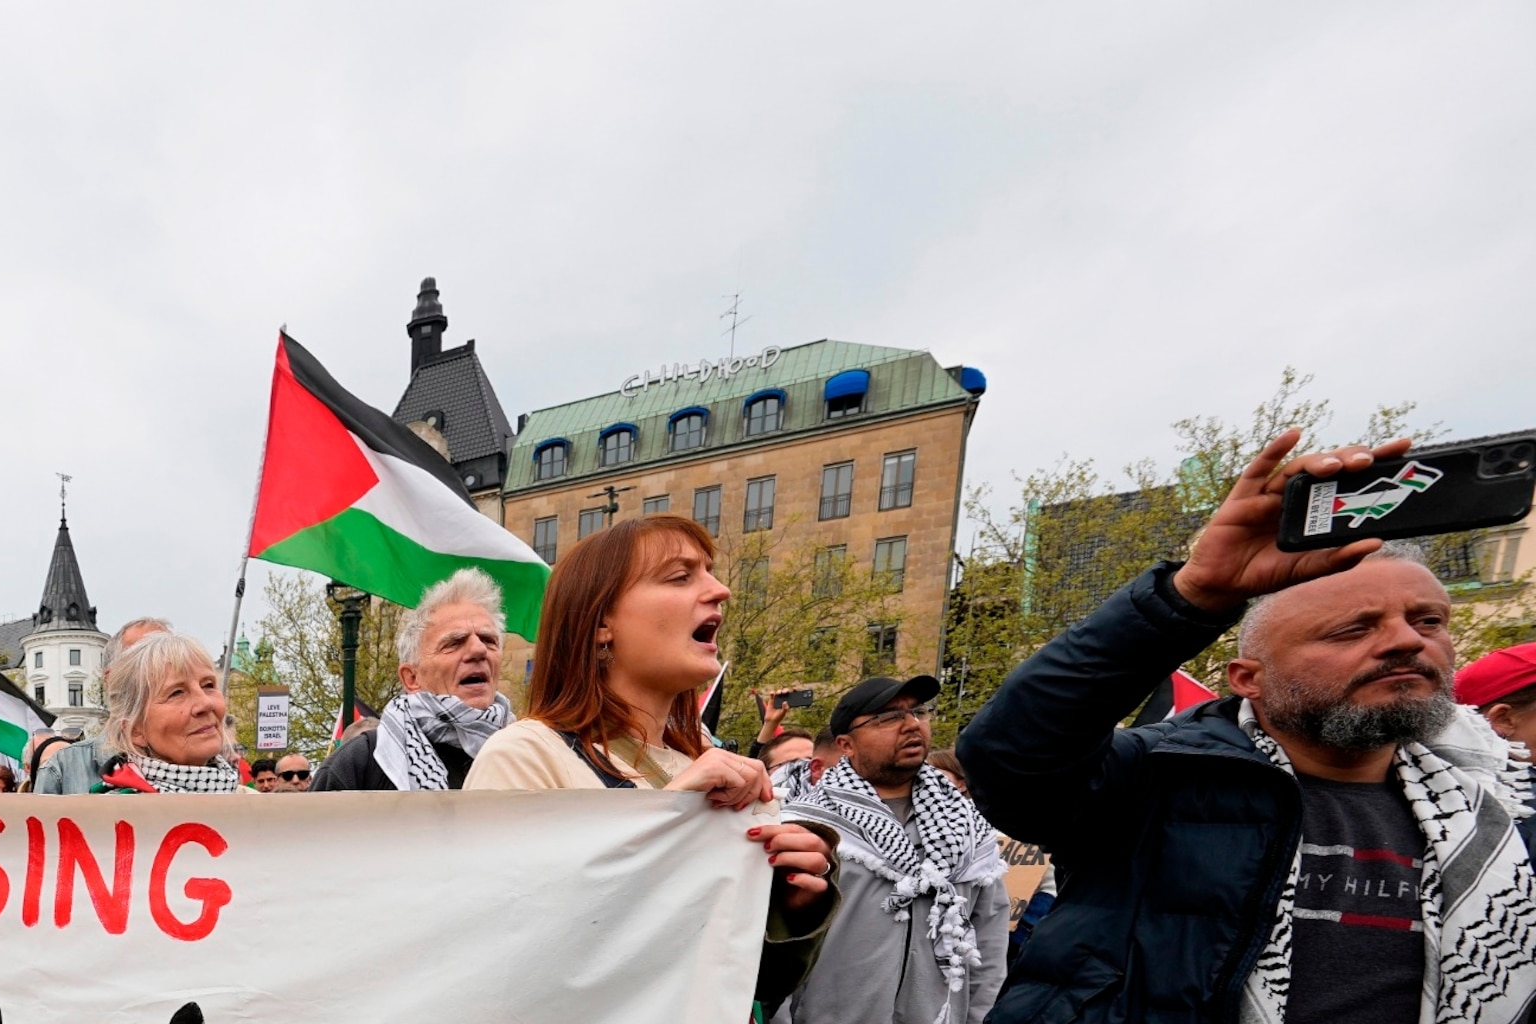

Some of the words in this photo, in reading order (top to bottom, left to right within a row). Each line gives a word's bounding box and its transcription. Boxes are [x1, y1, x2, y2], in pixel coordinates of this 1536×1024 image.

[619, 345, 782, 398] CHILDHOOD
[1310, 505, 1320, 515] BE
[1308, 516, 1318, 533] FREE
